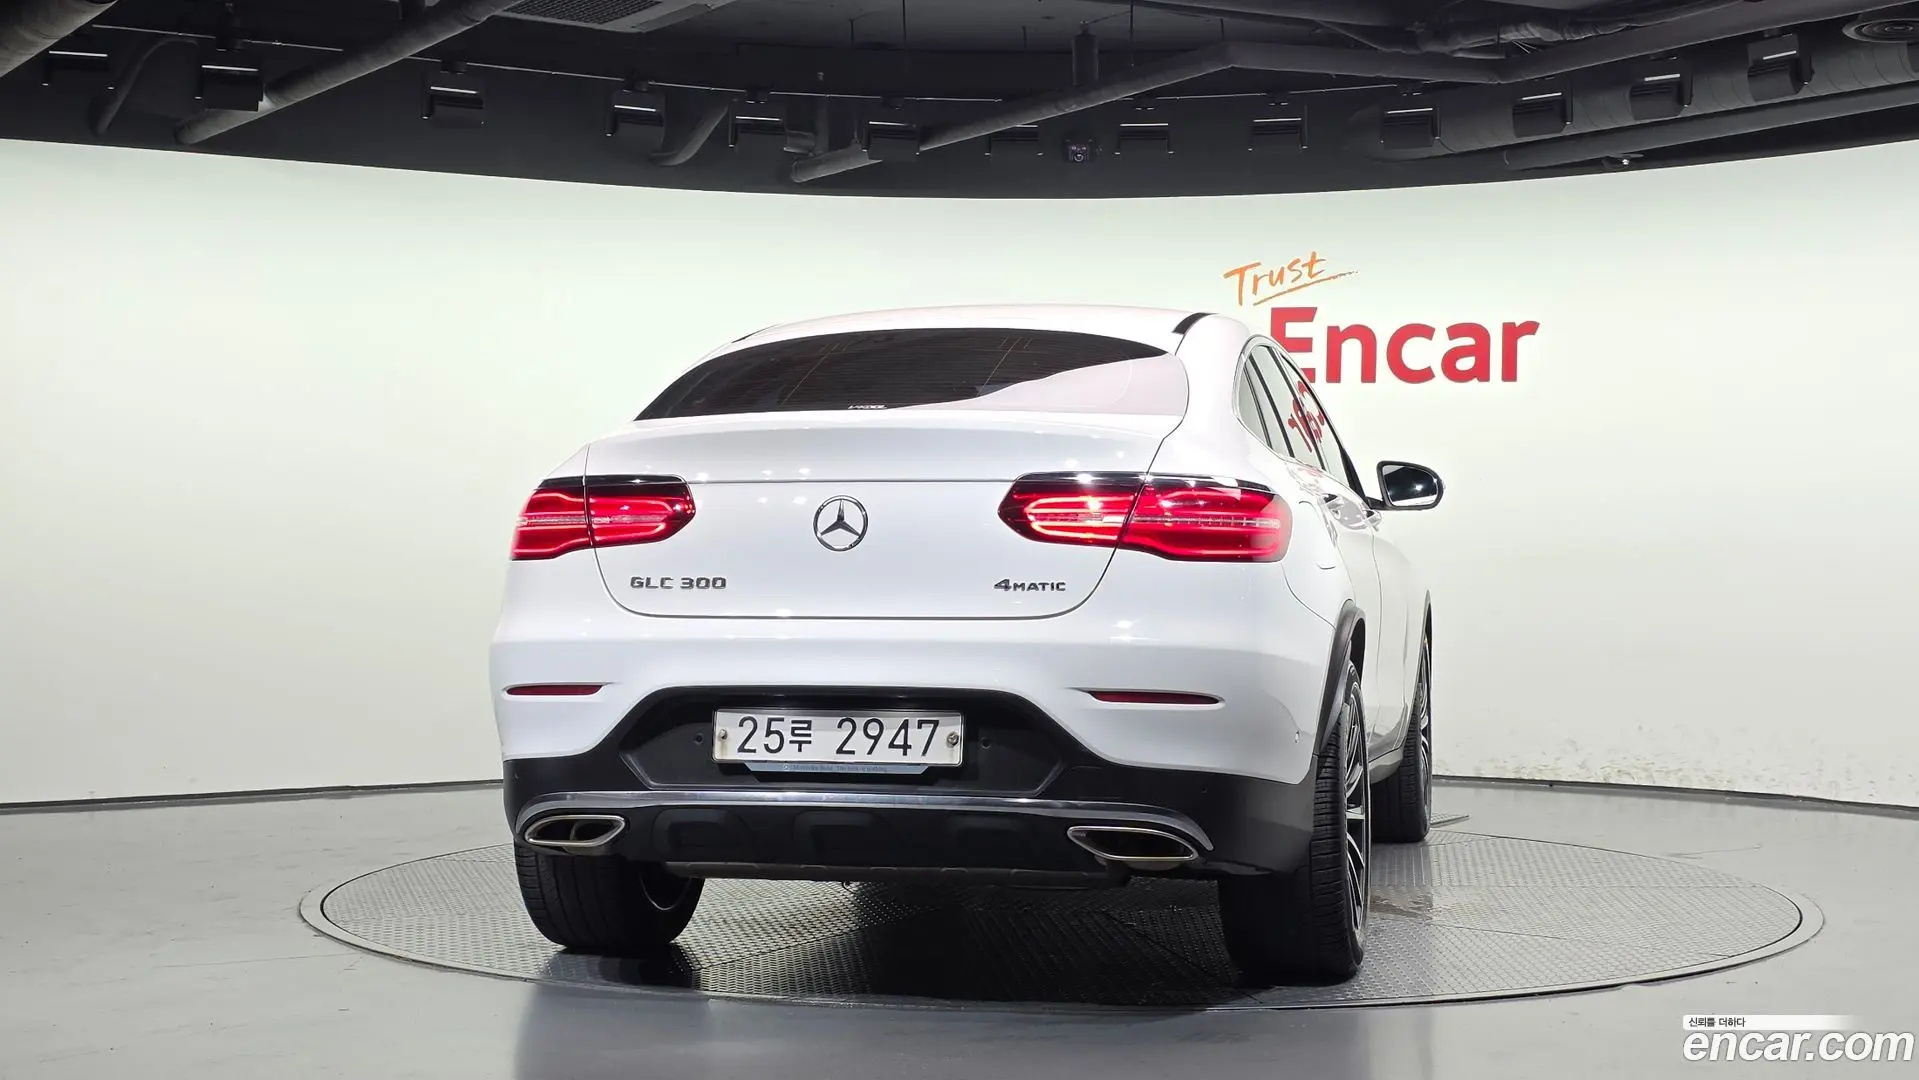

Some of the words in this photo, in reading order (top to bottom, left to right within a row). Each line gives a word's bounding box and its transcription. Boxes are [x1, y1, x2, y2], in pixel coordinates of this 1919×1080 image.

[1223, 251, 1326, 306] Trust
[1269, 306, 1541, 384] Encar
[630, 576, 674, 589] GLC
[680, 577, 726, 590] 300
[993, 578, 1066, 592] 4MATIC
[737, 715, 812, 753] 25루
[835, 717, 940, 757] 2947
